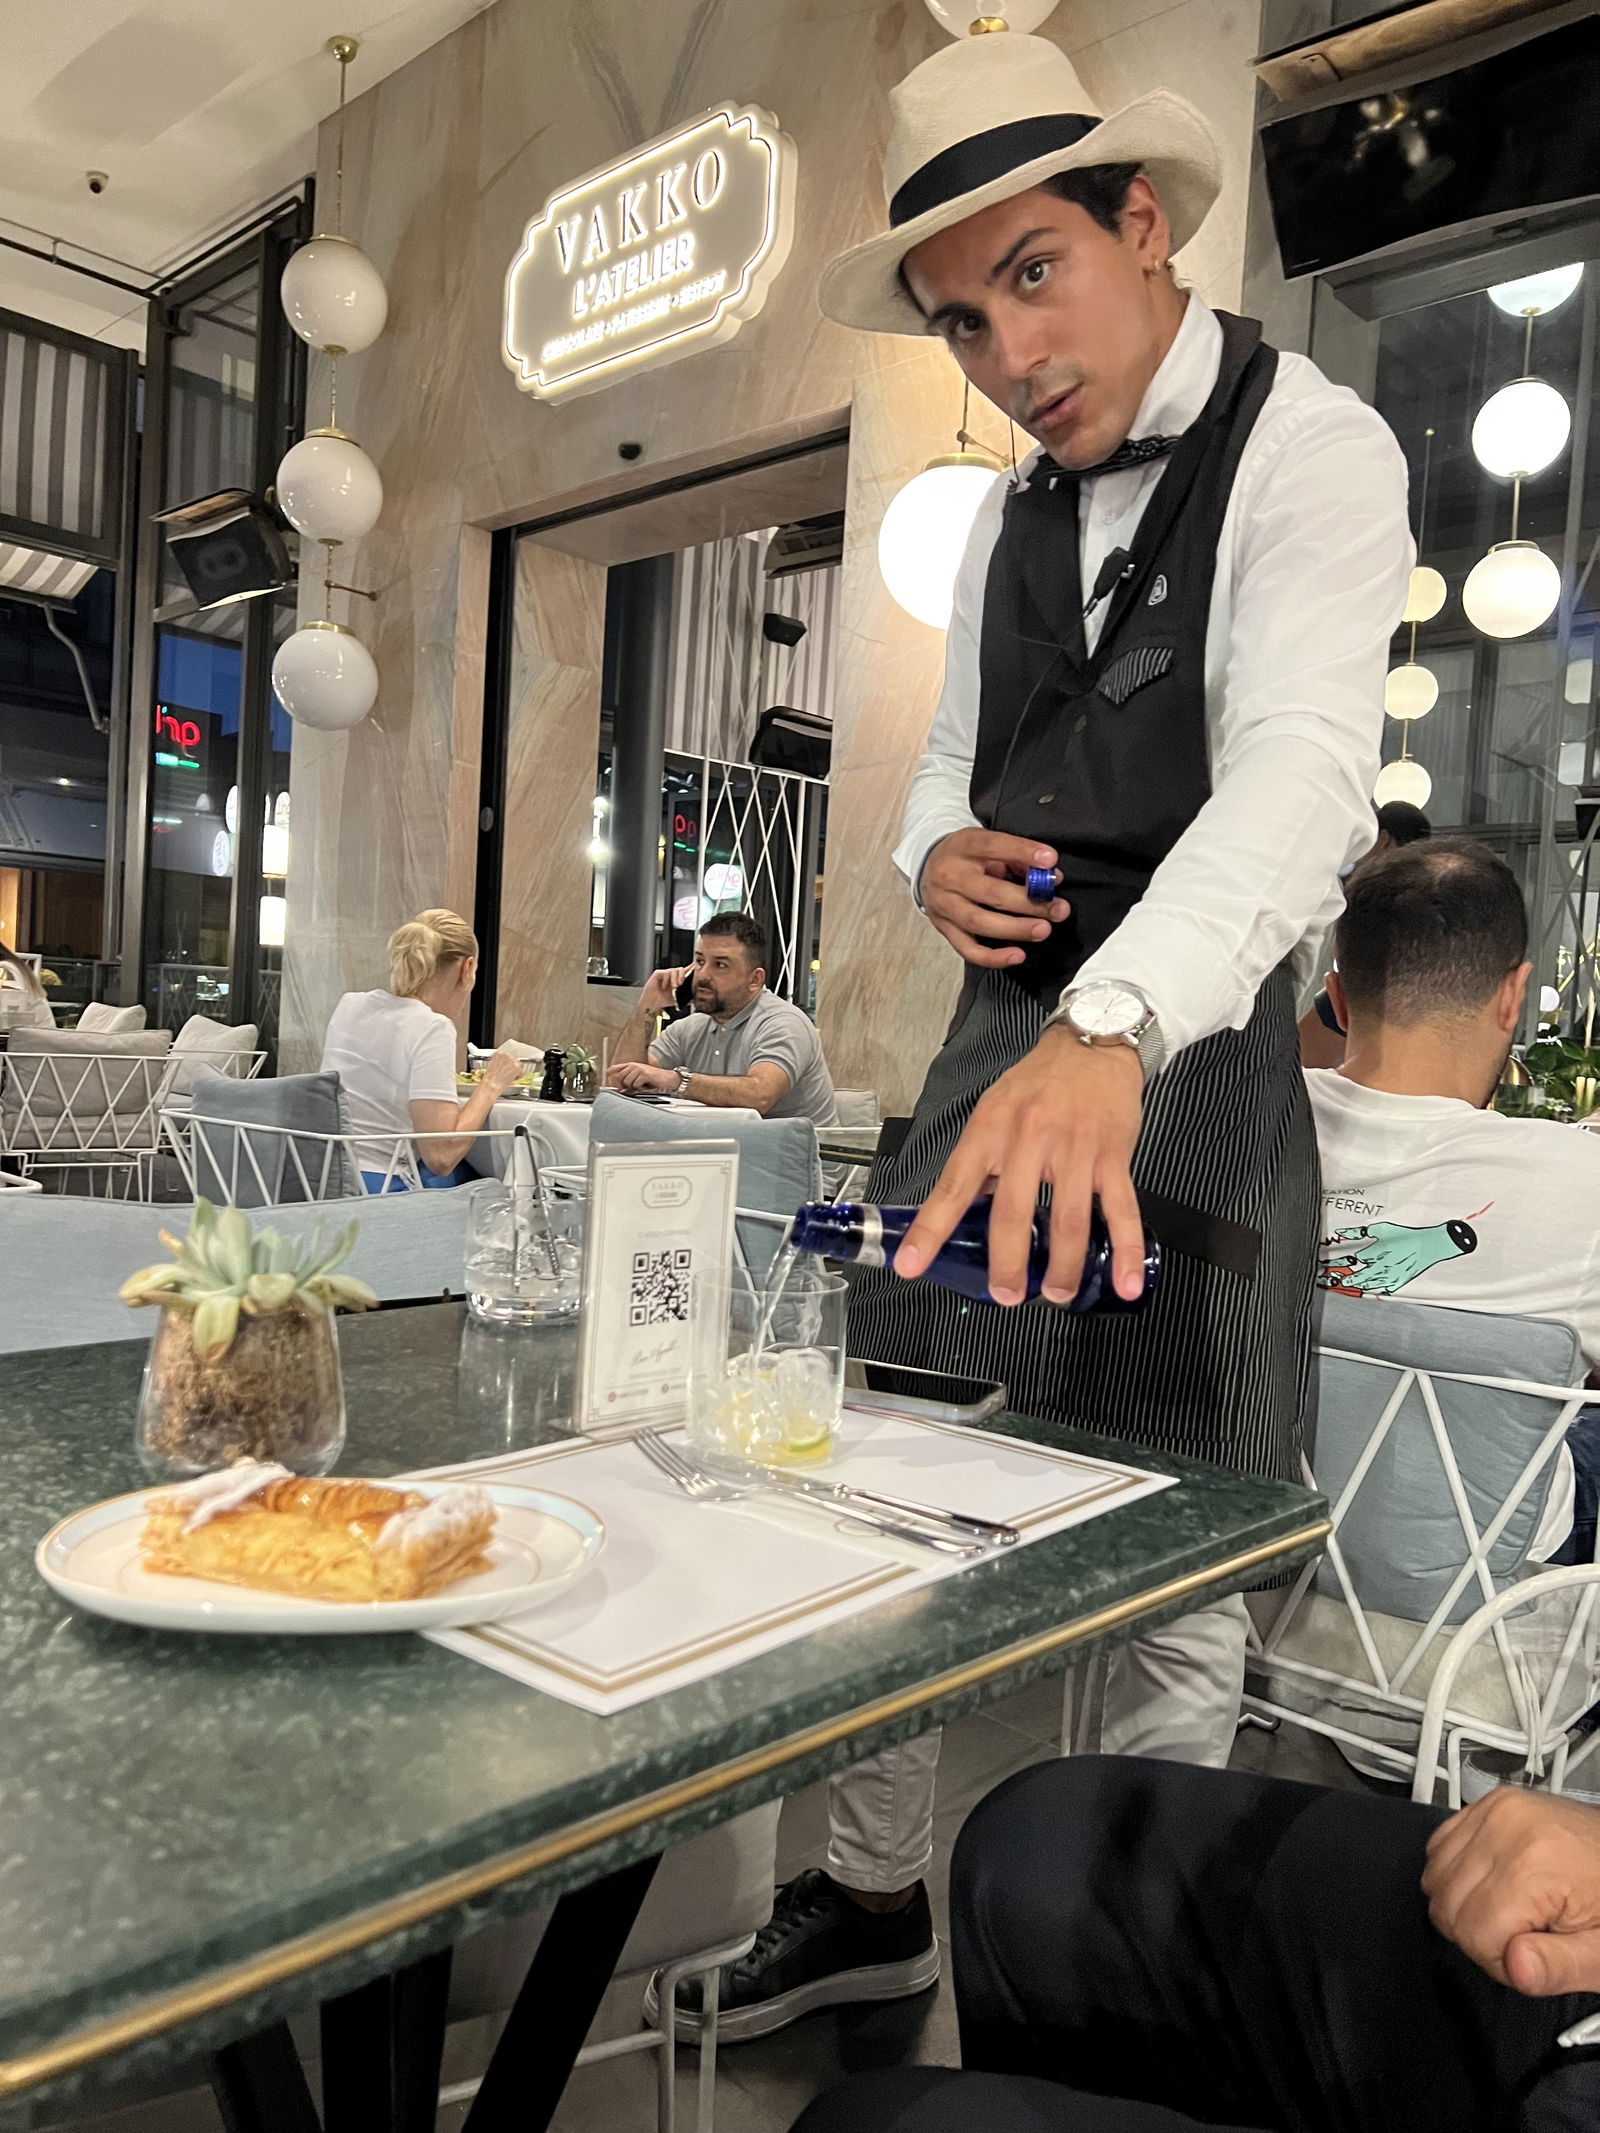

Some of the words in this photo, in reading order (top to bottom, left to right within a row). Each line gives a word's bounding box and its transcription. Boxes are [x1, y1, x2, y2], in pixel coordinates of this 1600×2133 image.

[555, 150, 725, 274] VAKKO
[572, 233, 695, 321] L'ATELIER
[1321, 1196, 1384, 1216] FERENT
